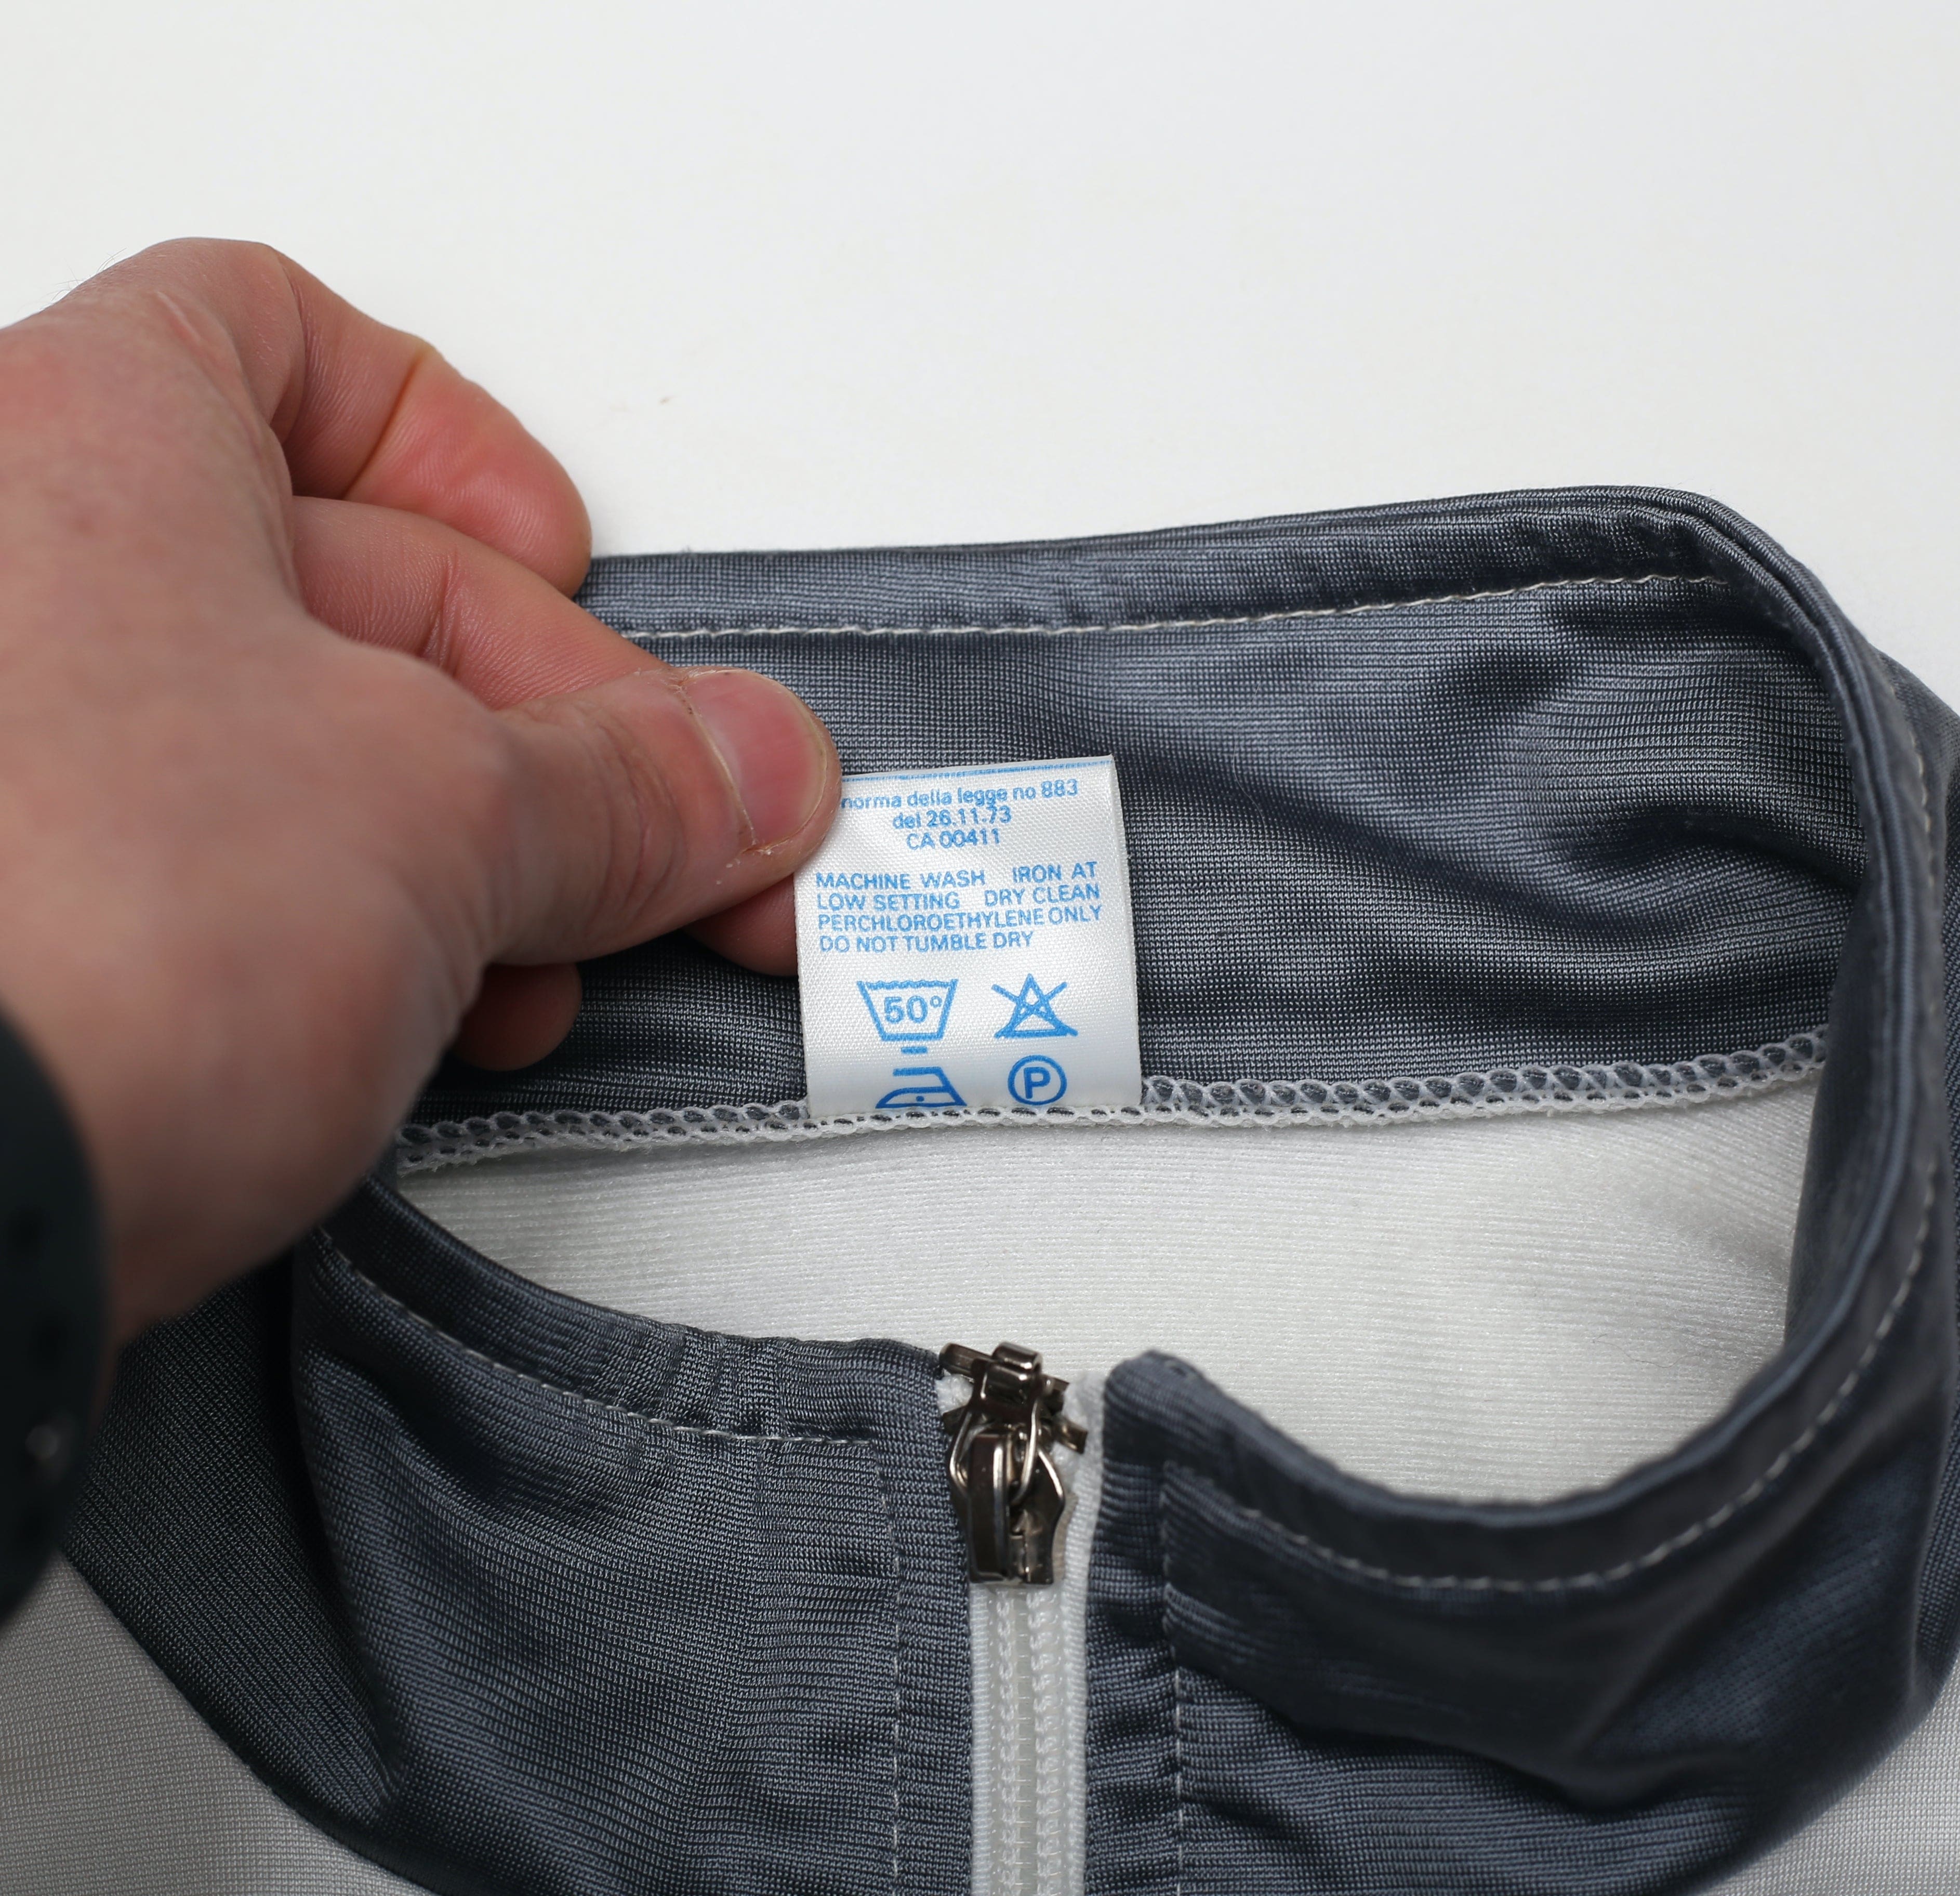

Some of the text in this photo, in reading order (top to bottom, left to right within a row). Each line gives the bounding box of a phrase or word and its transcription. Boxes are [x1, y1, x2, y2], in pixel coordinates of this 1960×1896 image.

[841, 780, 1078, 810] norma della legge no 883
[893, 807, 1012, 829] del 26.11.73
[906, 829, 1000, 849] CA 00411
[816, 861, 1098, 890] MACHINE WASH IRON AT
[817, 884, 1100, 911] LOW SETTING DRY CLEAN
[818, 904, 1102, 932] PERCHLOROETHYLENE ONLY
[820, 930, 1034, 953] DO NOT TUMBLE DRY
[1023, 1066, 1051, 1099] P
